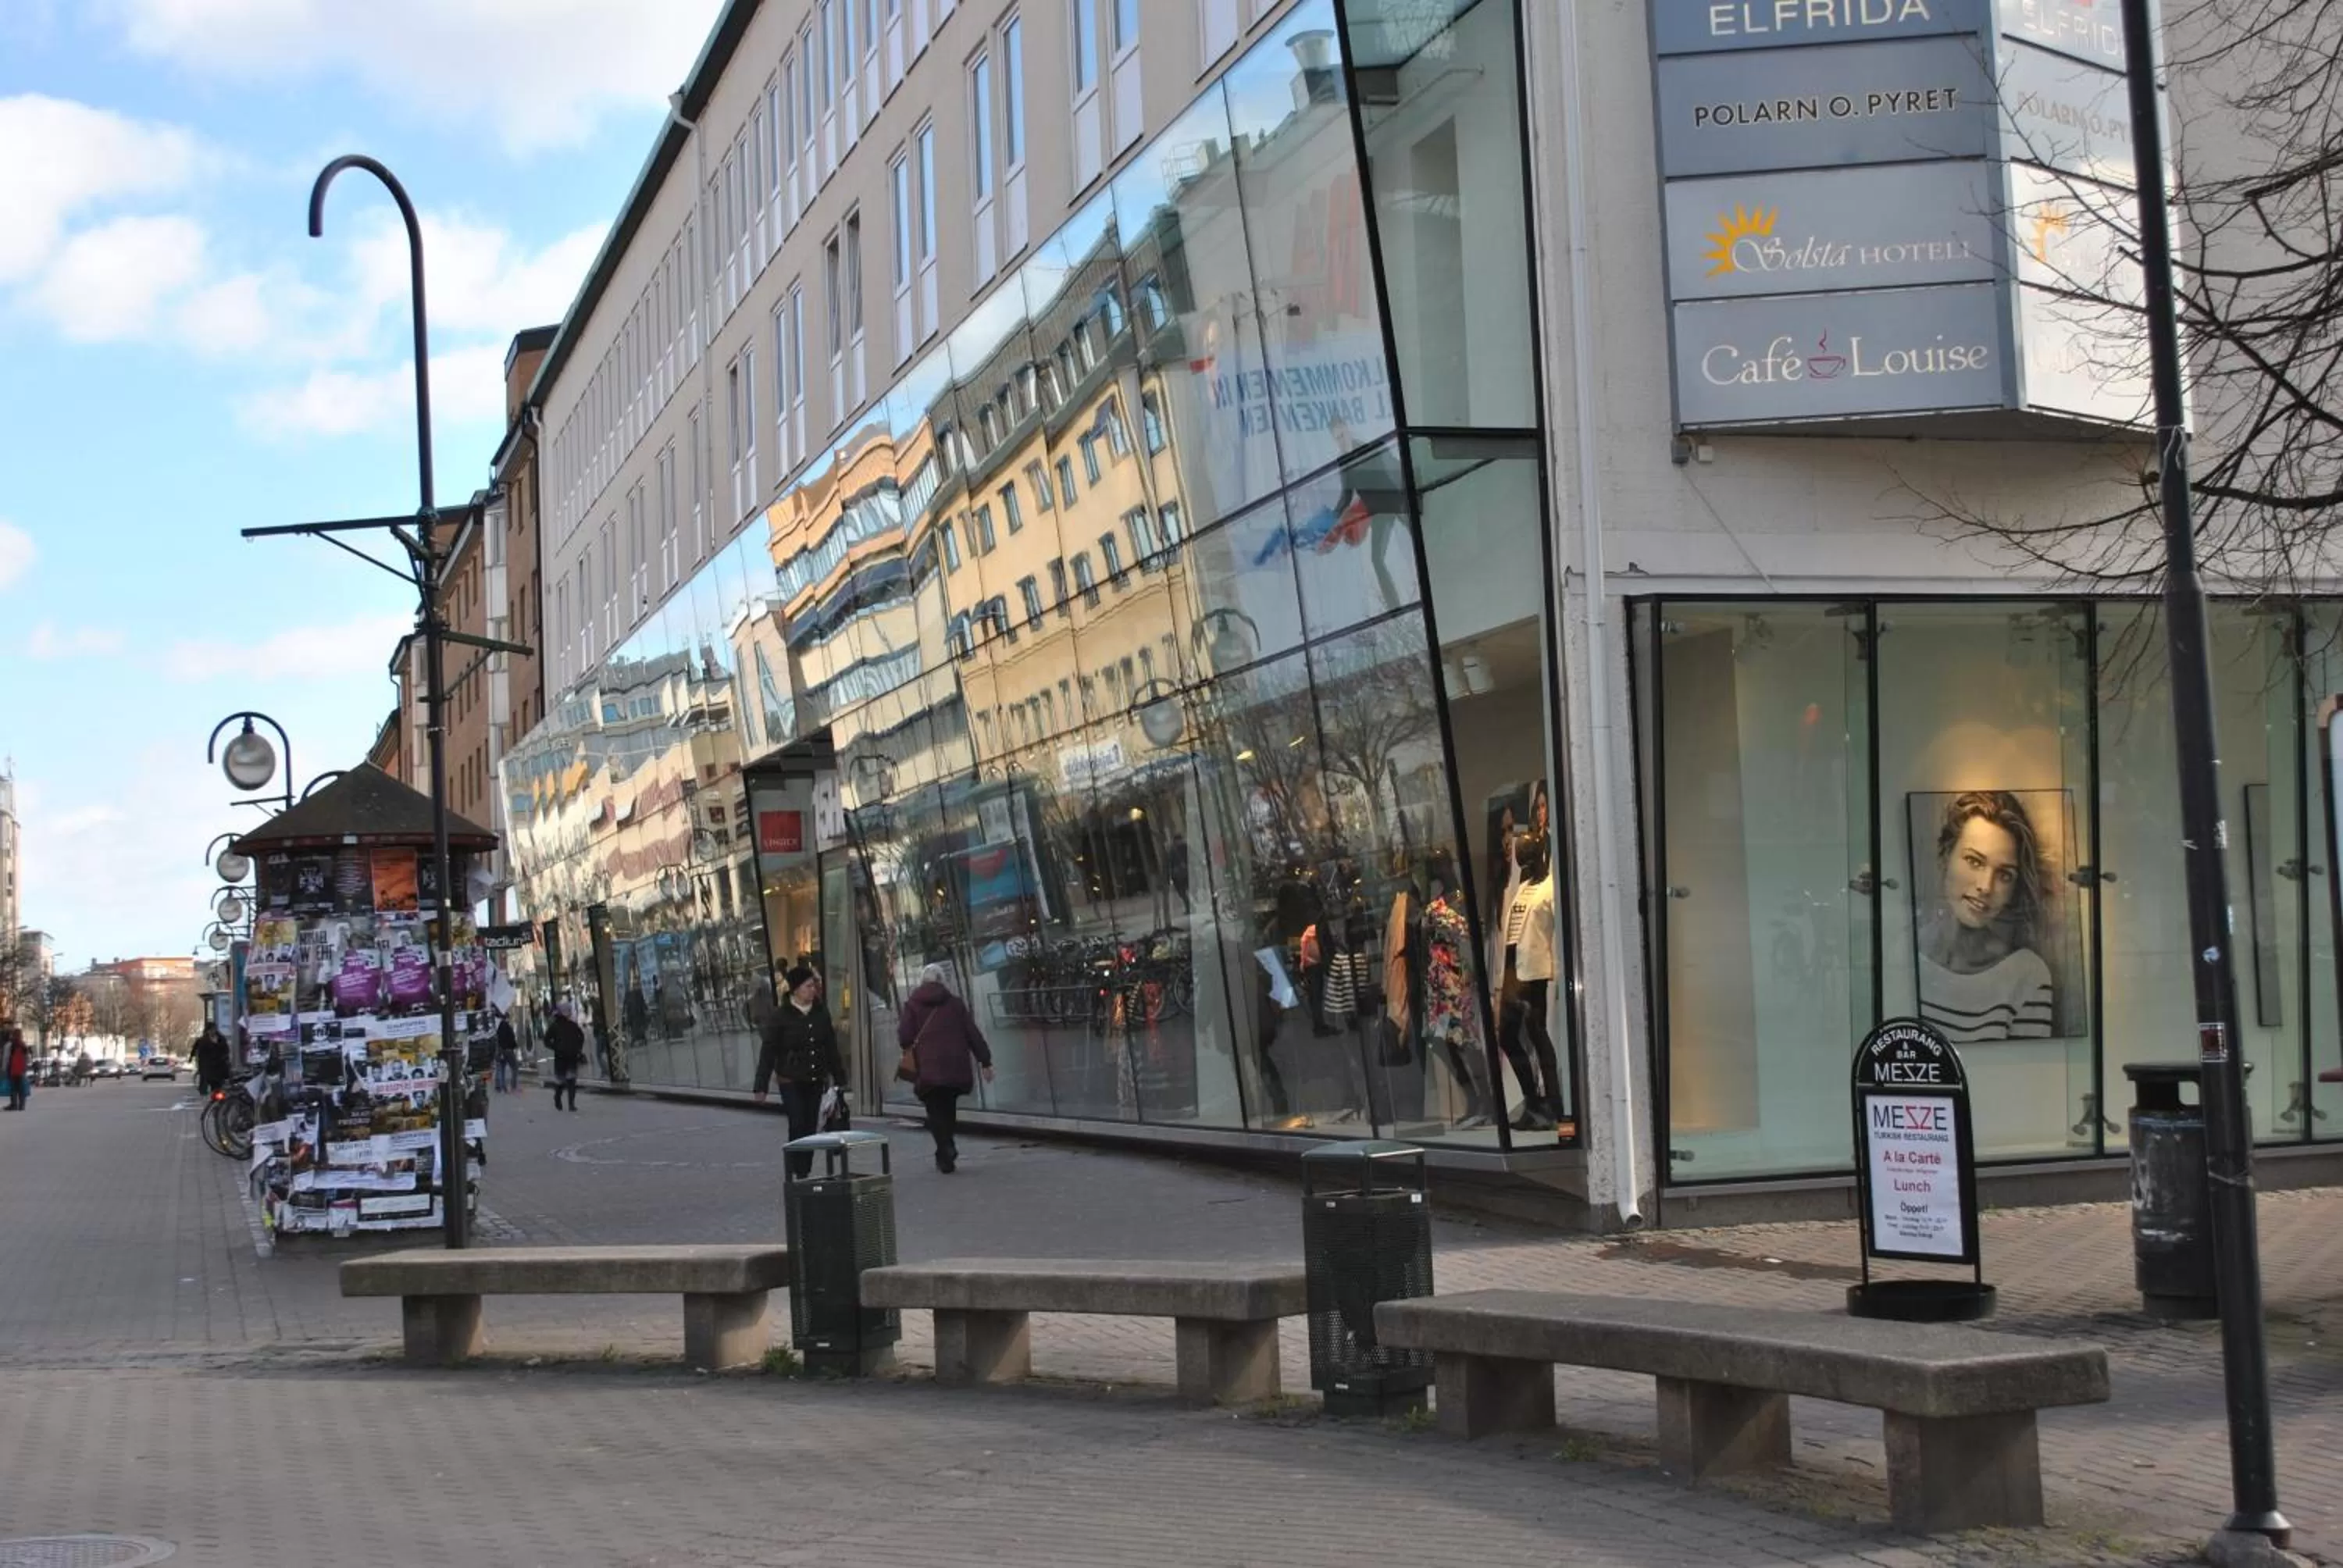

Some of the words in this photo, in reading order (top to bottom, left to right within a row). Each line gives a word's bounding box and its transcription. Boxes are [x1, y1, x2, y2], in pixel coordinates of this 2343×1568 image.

[1709, 0, 1931, 35] ELFRIDA
[2022, 0, 2118, 55] ELFRID
[1694, 98, 1819, 127] POLARN
[1867, 87, 1958, 114] PYRET
[1731, 235, 1853, 273] Solsta
[1702, 336, 1803, 386] Café
[1849, 334, 1988, 378] Louise
[1871, 1028, 1942, 1057] RESTAURANG
[1896, 1050, 1916, 1060] BAR
[1874, 1063, 1941, 1082] MEZZE
[1874, 1106, 1947, 1131] MEZZE
[1883, 1150, 1892, 1163] A
[1895, 1152, 1905, 1163] la
[1894, 1178, 1931, 1193] Lunch
